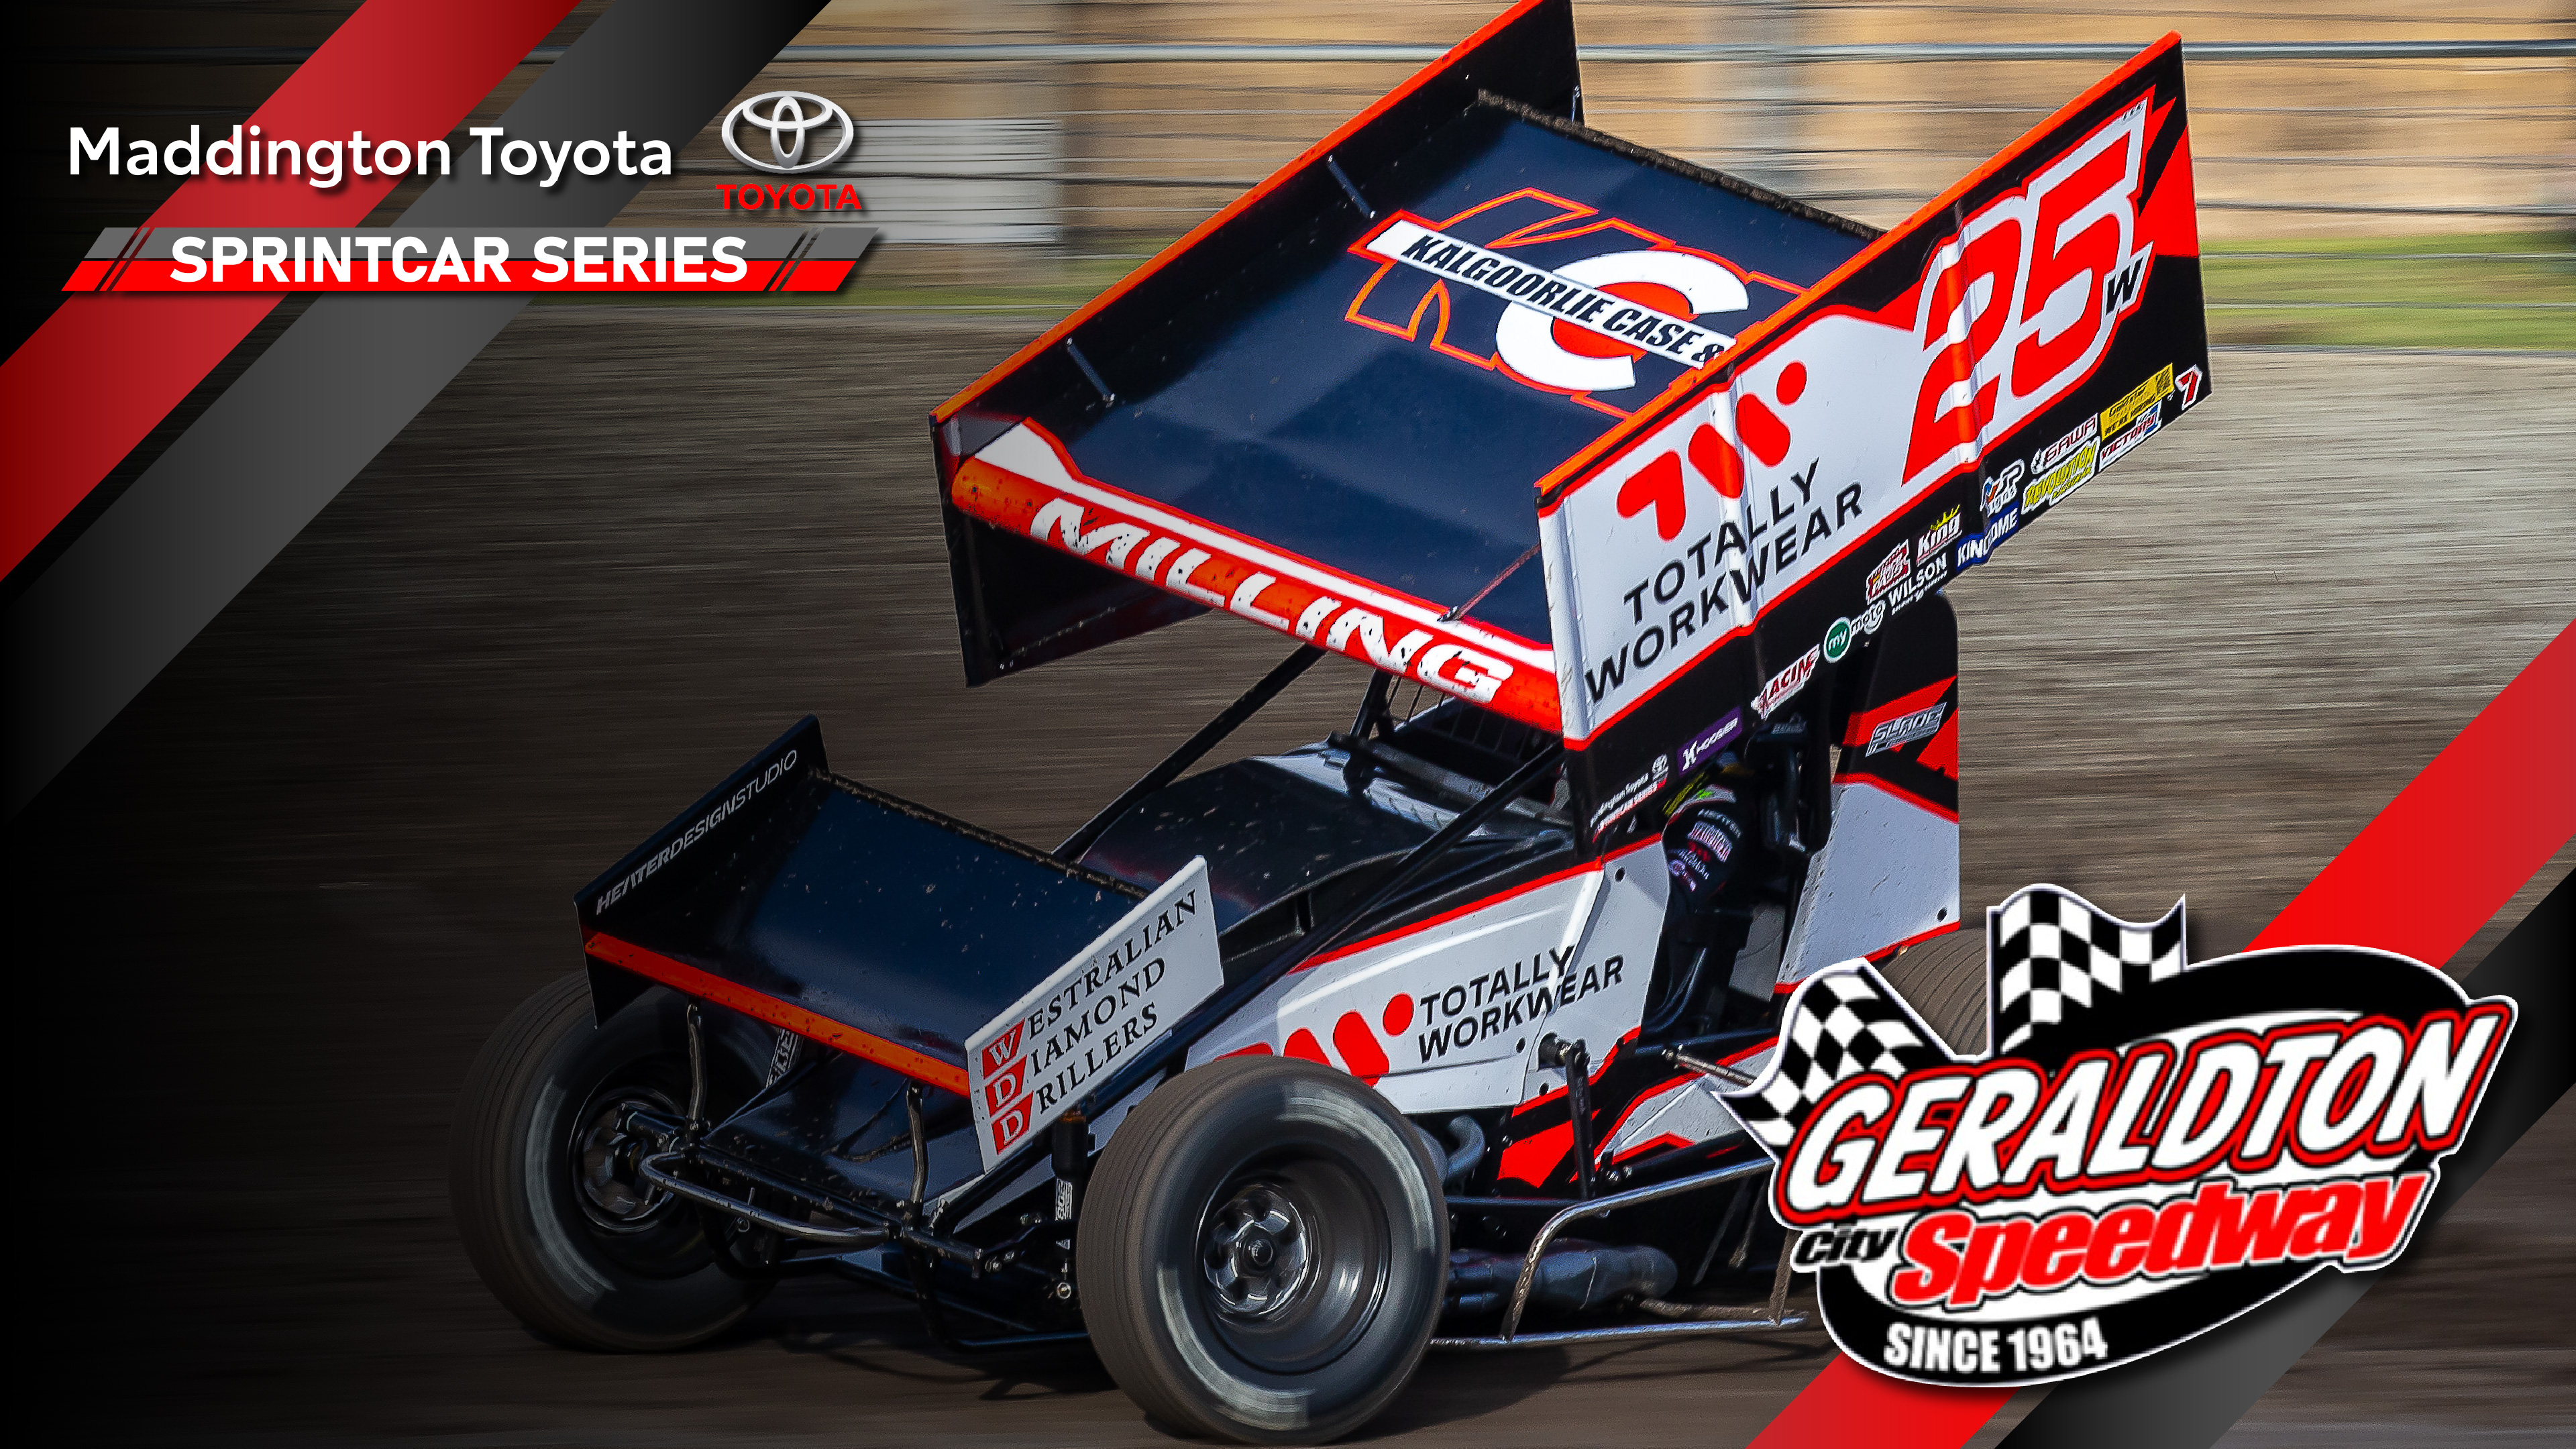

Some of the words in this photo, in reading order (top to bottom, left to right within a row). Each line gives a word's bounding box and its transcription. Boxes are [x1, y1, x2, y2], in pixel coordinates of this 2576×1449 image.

[1402, 235, 1605, 323] KALGOORLIE
[1608, 307, 1695, 354] CASE
[1691, 343, 1725, 364] &
[1903, 101, 2147, 484] 25
[2024, 441, 2097, 508] REVOLUTION
[2101, 412, 2157, 461] VICTORY
[1031, 497, 1514, 704] MILLING
[1585, 482, 1863, 704] WORKWEAR
[1623, 457, 1819, 626] TOTALLY
[1888, 552, 1947, 607] WILSON
[1417, 955, 1624, 1064] WORKWEAR
[1419, 946, 1574, 1026] TOTALLY
